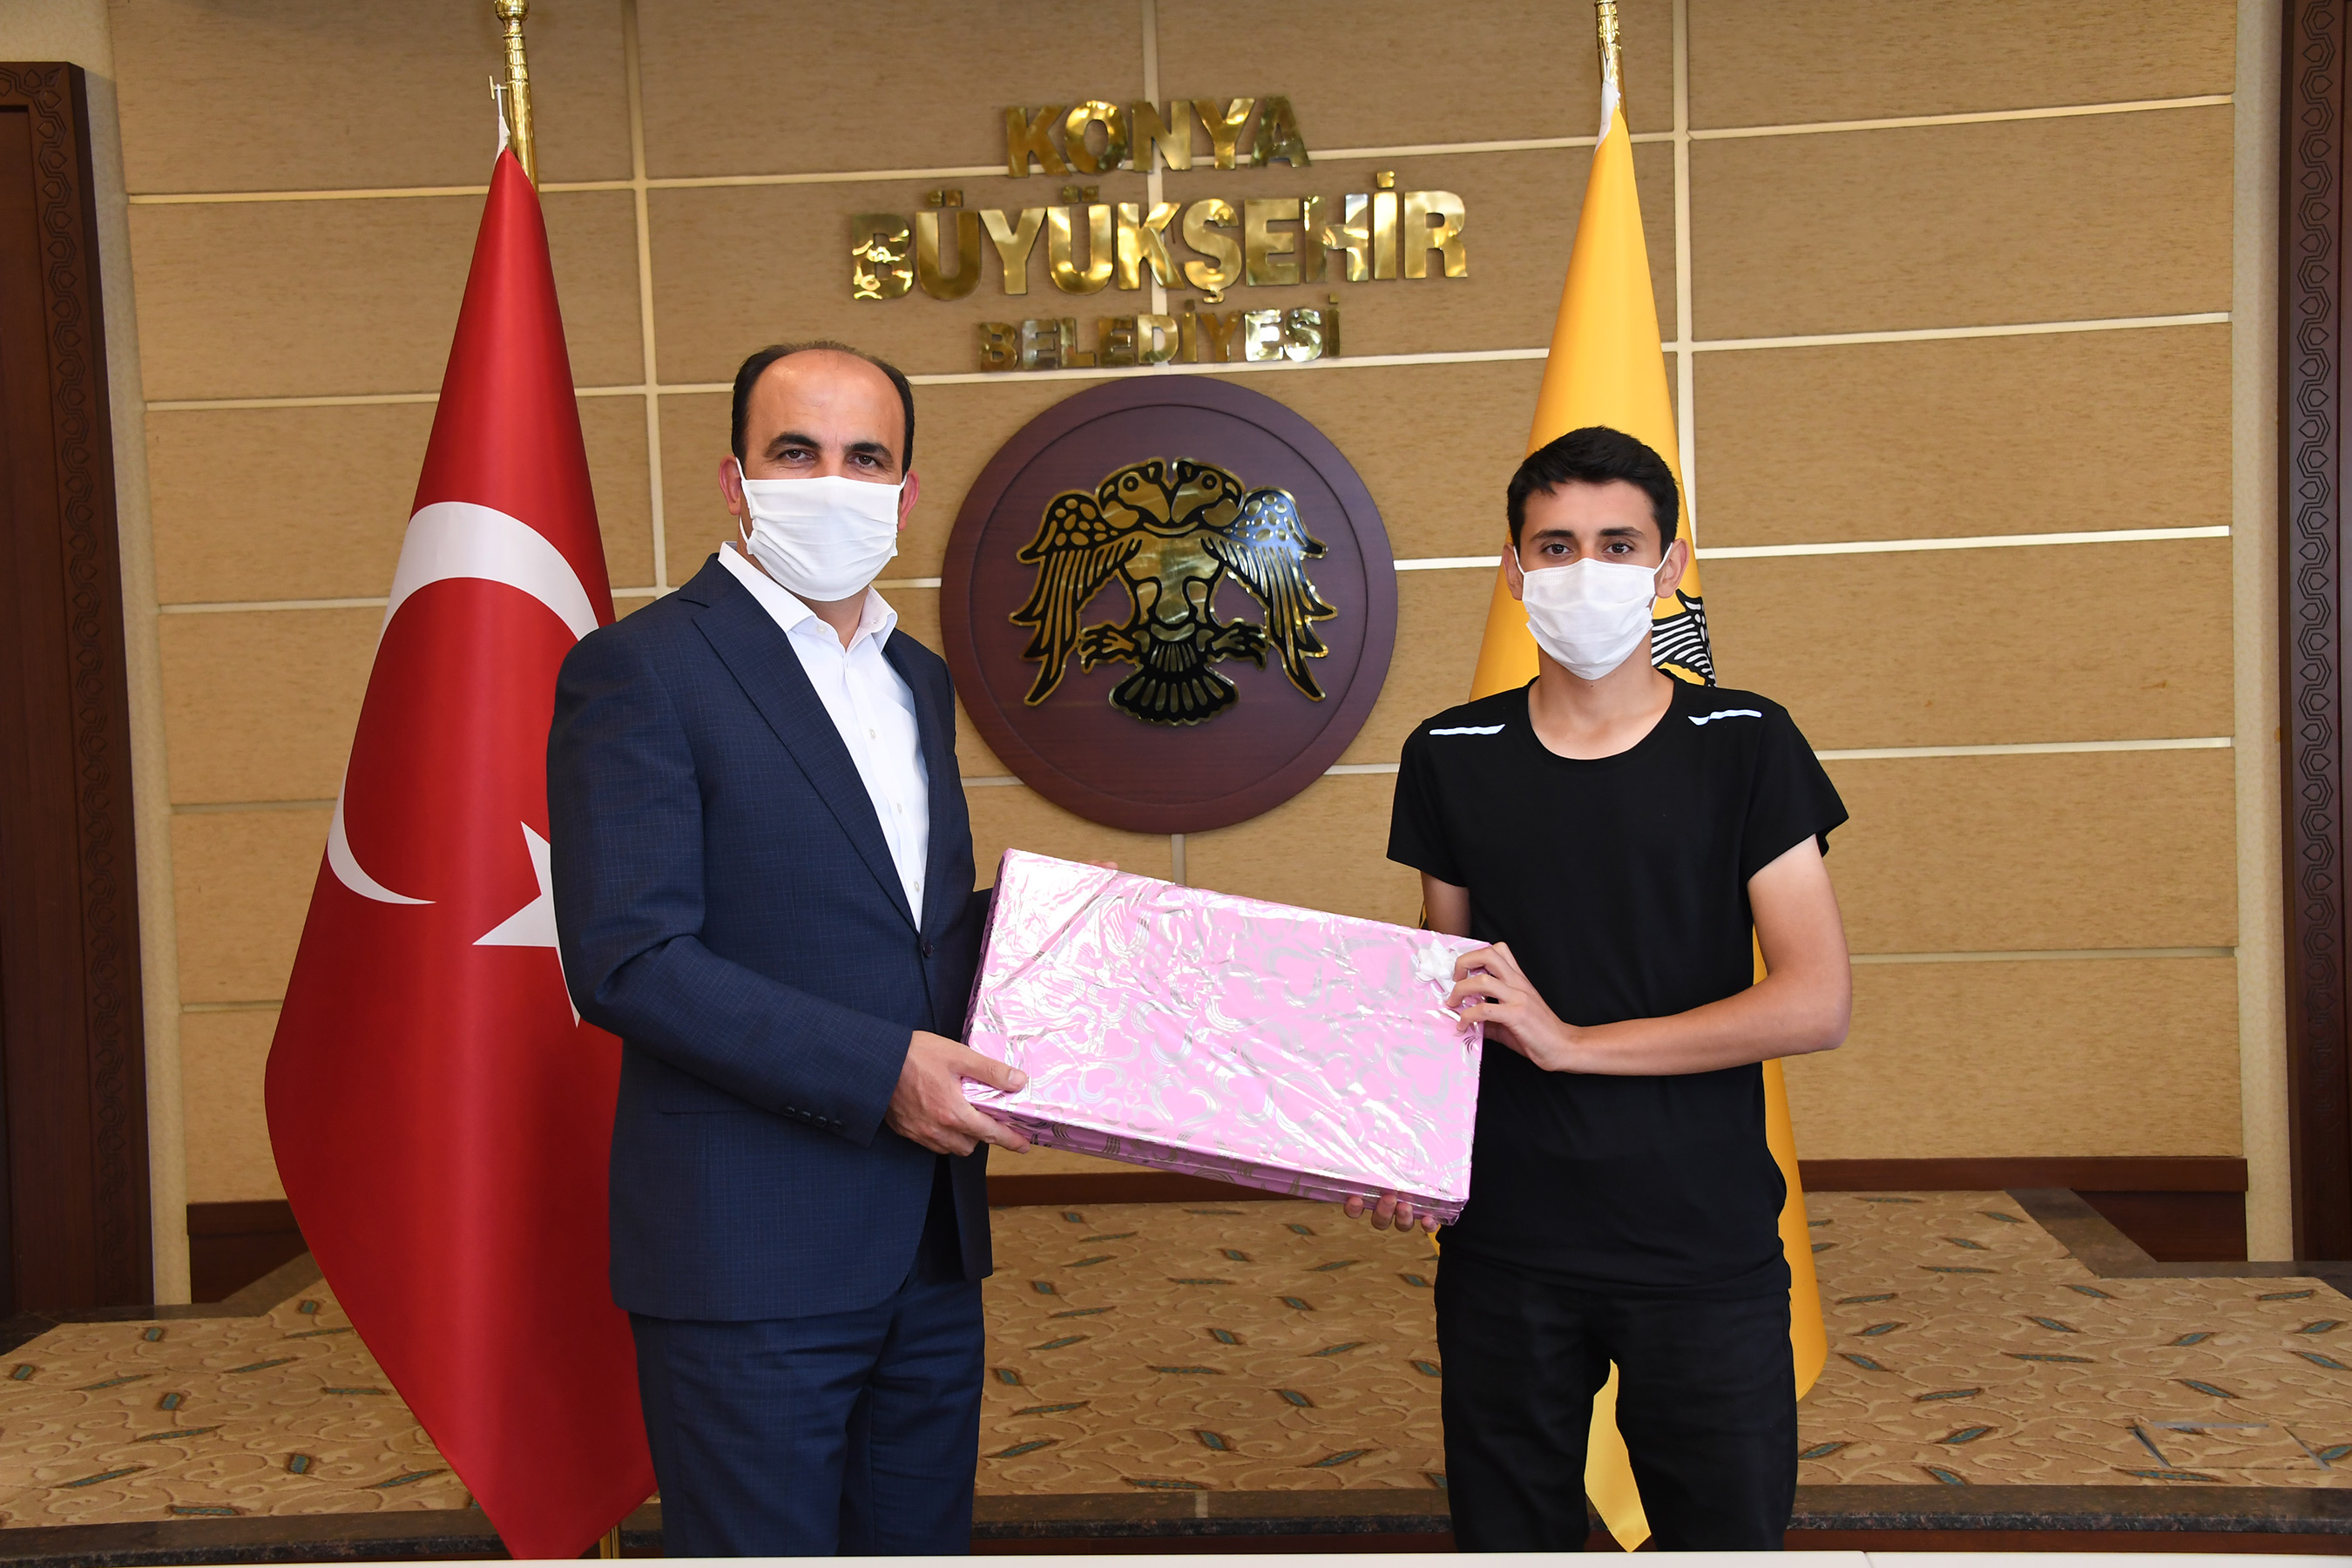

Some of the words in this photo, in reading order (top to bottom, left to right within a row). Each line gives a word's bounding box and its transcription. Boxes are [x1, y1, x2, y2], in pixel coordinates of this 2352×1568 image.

[1005, 97, 1310, 178] KONYA
[852, 171, 1469, 303] BÜYÜKŞEHİR
[978, 293, 1341, 372] BELEDİYESİ
